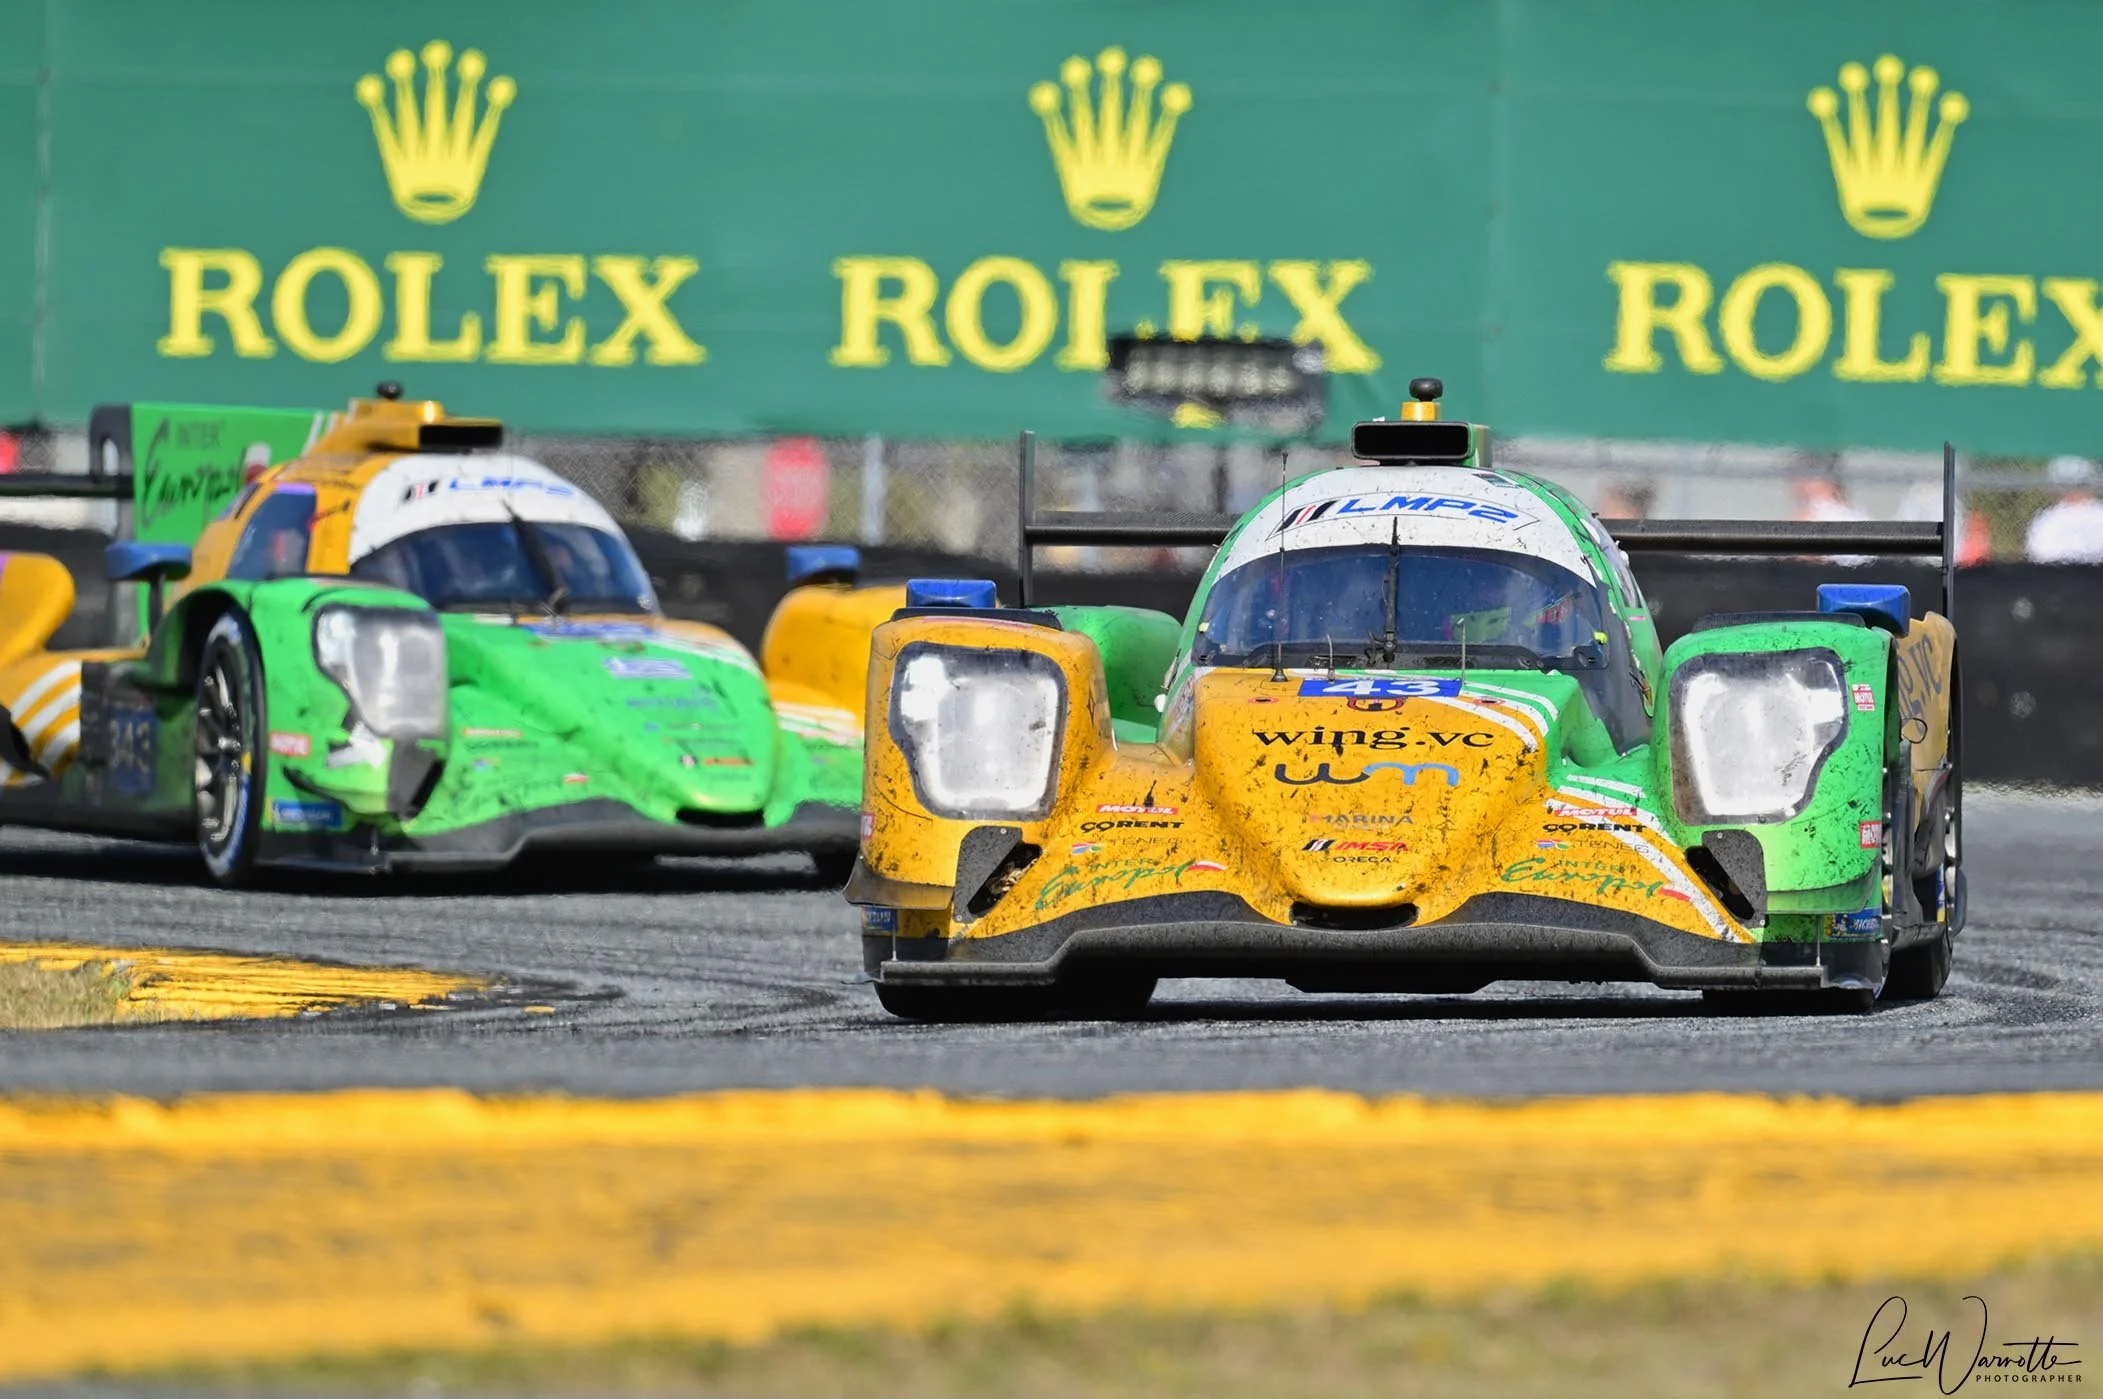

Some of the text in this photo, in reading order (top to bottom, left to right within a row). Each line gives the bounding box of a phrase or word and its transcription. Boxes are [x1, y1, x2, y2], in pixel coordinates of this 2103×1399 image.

[159, 248, 702, 365] ROLEX
[1338, 496, 1520, 524] LMP2
[1322, 680, 1441, 696] 43
[1253, 726, 1495, 751] wing.vc
[1558, 808, 1635, 816] MOTUL
[1080, 820, 1185, 833] CORENT
[1543, 822, 1648, 833] CORENT
[1335, 841, 1409, 851] IMSA
[1089, 858, 1154, 871] INTER
[1557, 859, 1627, 873] INTER
[1501, 857, 1665, 898] Europol
